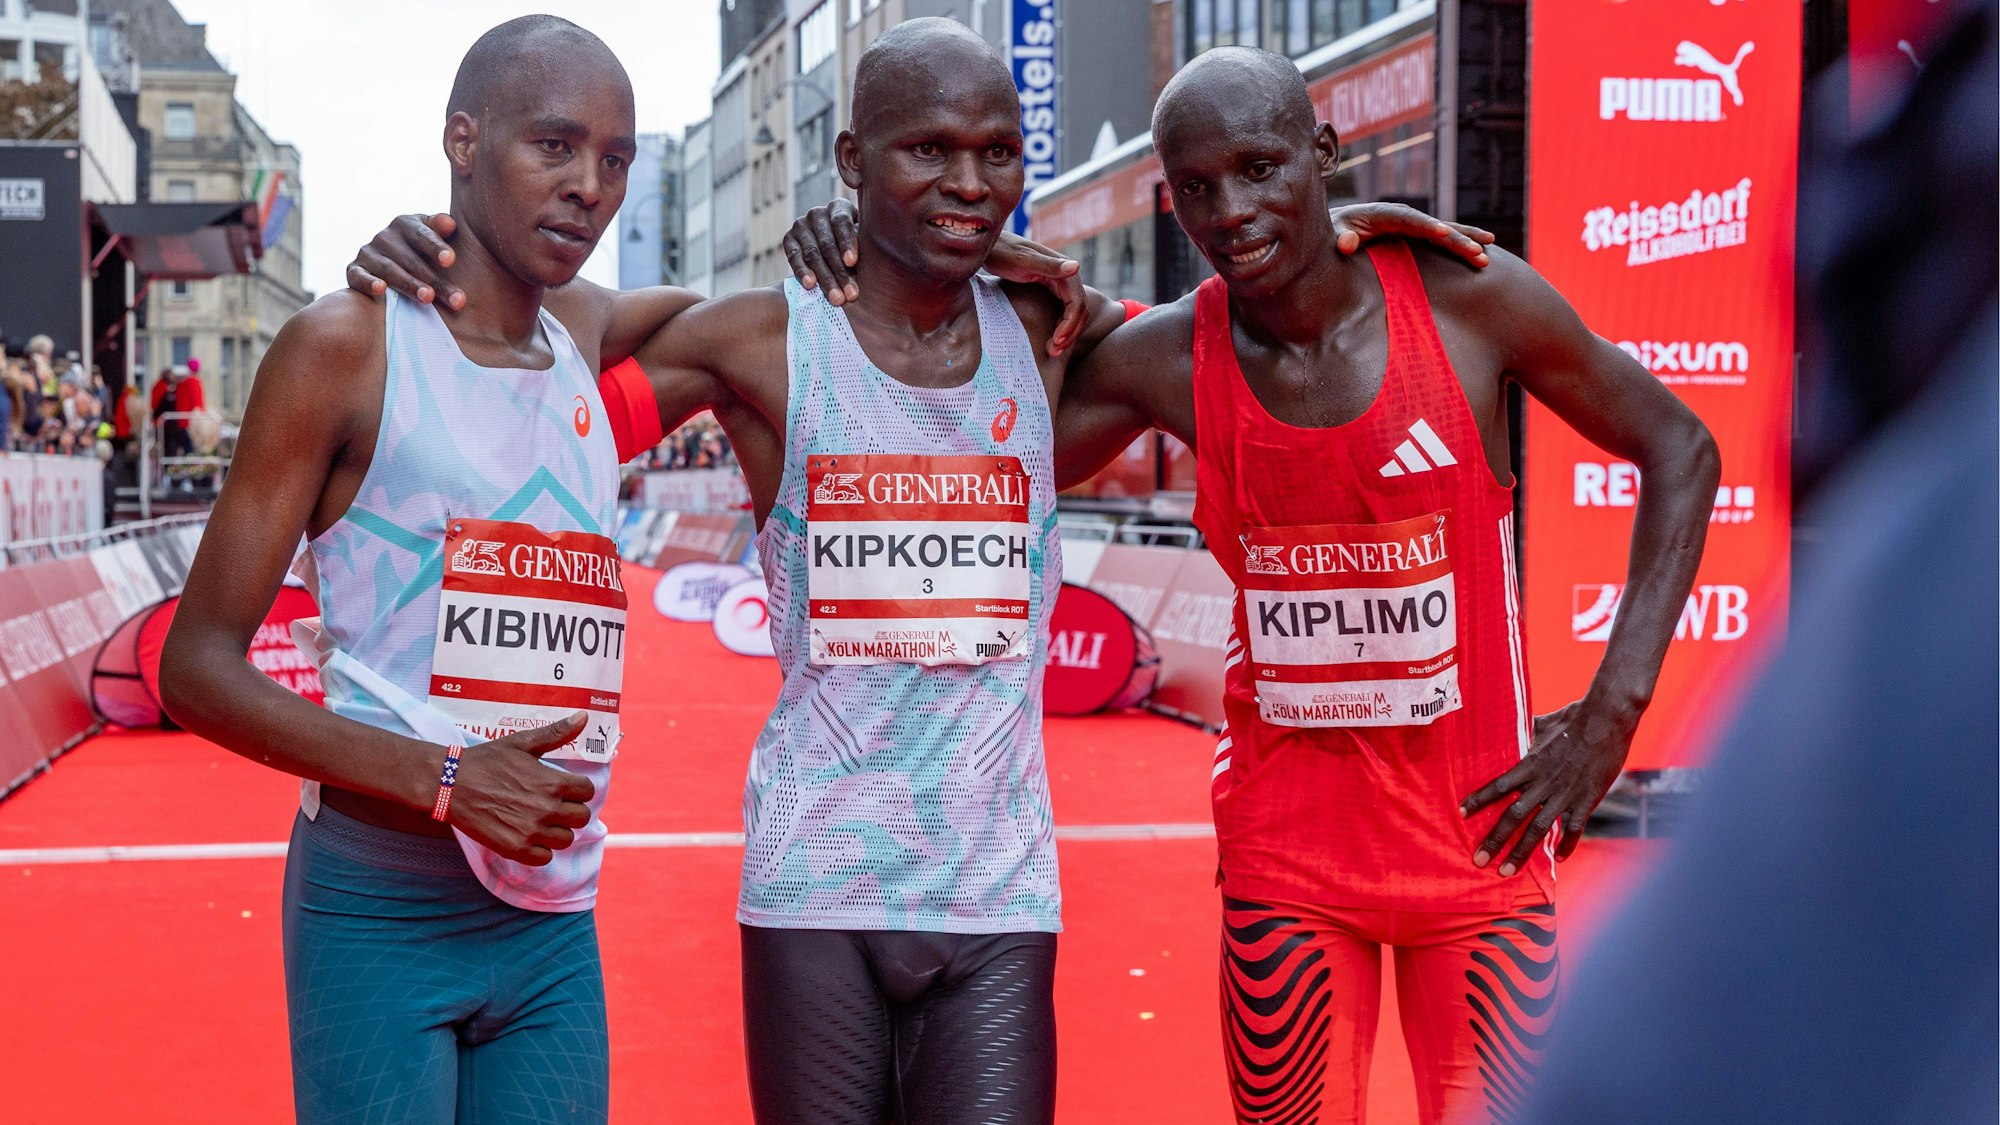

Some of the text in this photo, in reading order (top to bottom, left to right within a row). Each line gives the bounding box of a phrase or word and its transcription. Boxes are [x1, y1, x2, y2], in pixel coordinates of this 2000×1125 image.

[1600, 77, 1721, 122] PUMA
[1014, 0, 1055, 240] hostels.
[1581, 177, 1751, 252] Reissdorf
[1626, 220, 1747, 267] ALKOHOLFREI
[868, 472, 1025, 506] GENERALI
[1574, 463, 1641, 507] RE
[814, 534, 1027, 569] KIPKOECH
[1290, 529, 1448, 575] GENERALI
[922, 578, 934, 594] 3
[820, 604, 1025, 615] 42.2 Startblock ROT
[1258, 590, 1448, 637] KIPLIMO
[1673, 585, 1749, 641] WB
[443, 604, 626, 660] KIBIWOTT
[889, 630, 935, 639] GENERALI
[828, 641, 936, 658] KÖLN MARATHON
[1354, 643, 1365, 657] 7
[554, 663, 564, 680] 6
[1261, 654, 1454, 678] 42.2 Startblock ROT
[441, 683, 462, 693] 42.2
[590, 695, 608, 708] Startblock
[1325, 693, 1370, 702] GENERALI
[1411, 698, 1444, 718] PUMA
[1272, 703, 1372, 720] KÖLN MARATHON
[585, 737, 605, 755] PUMA
